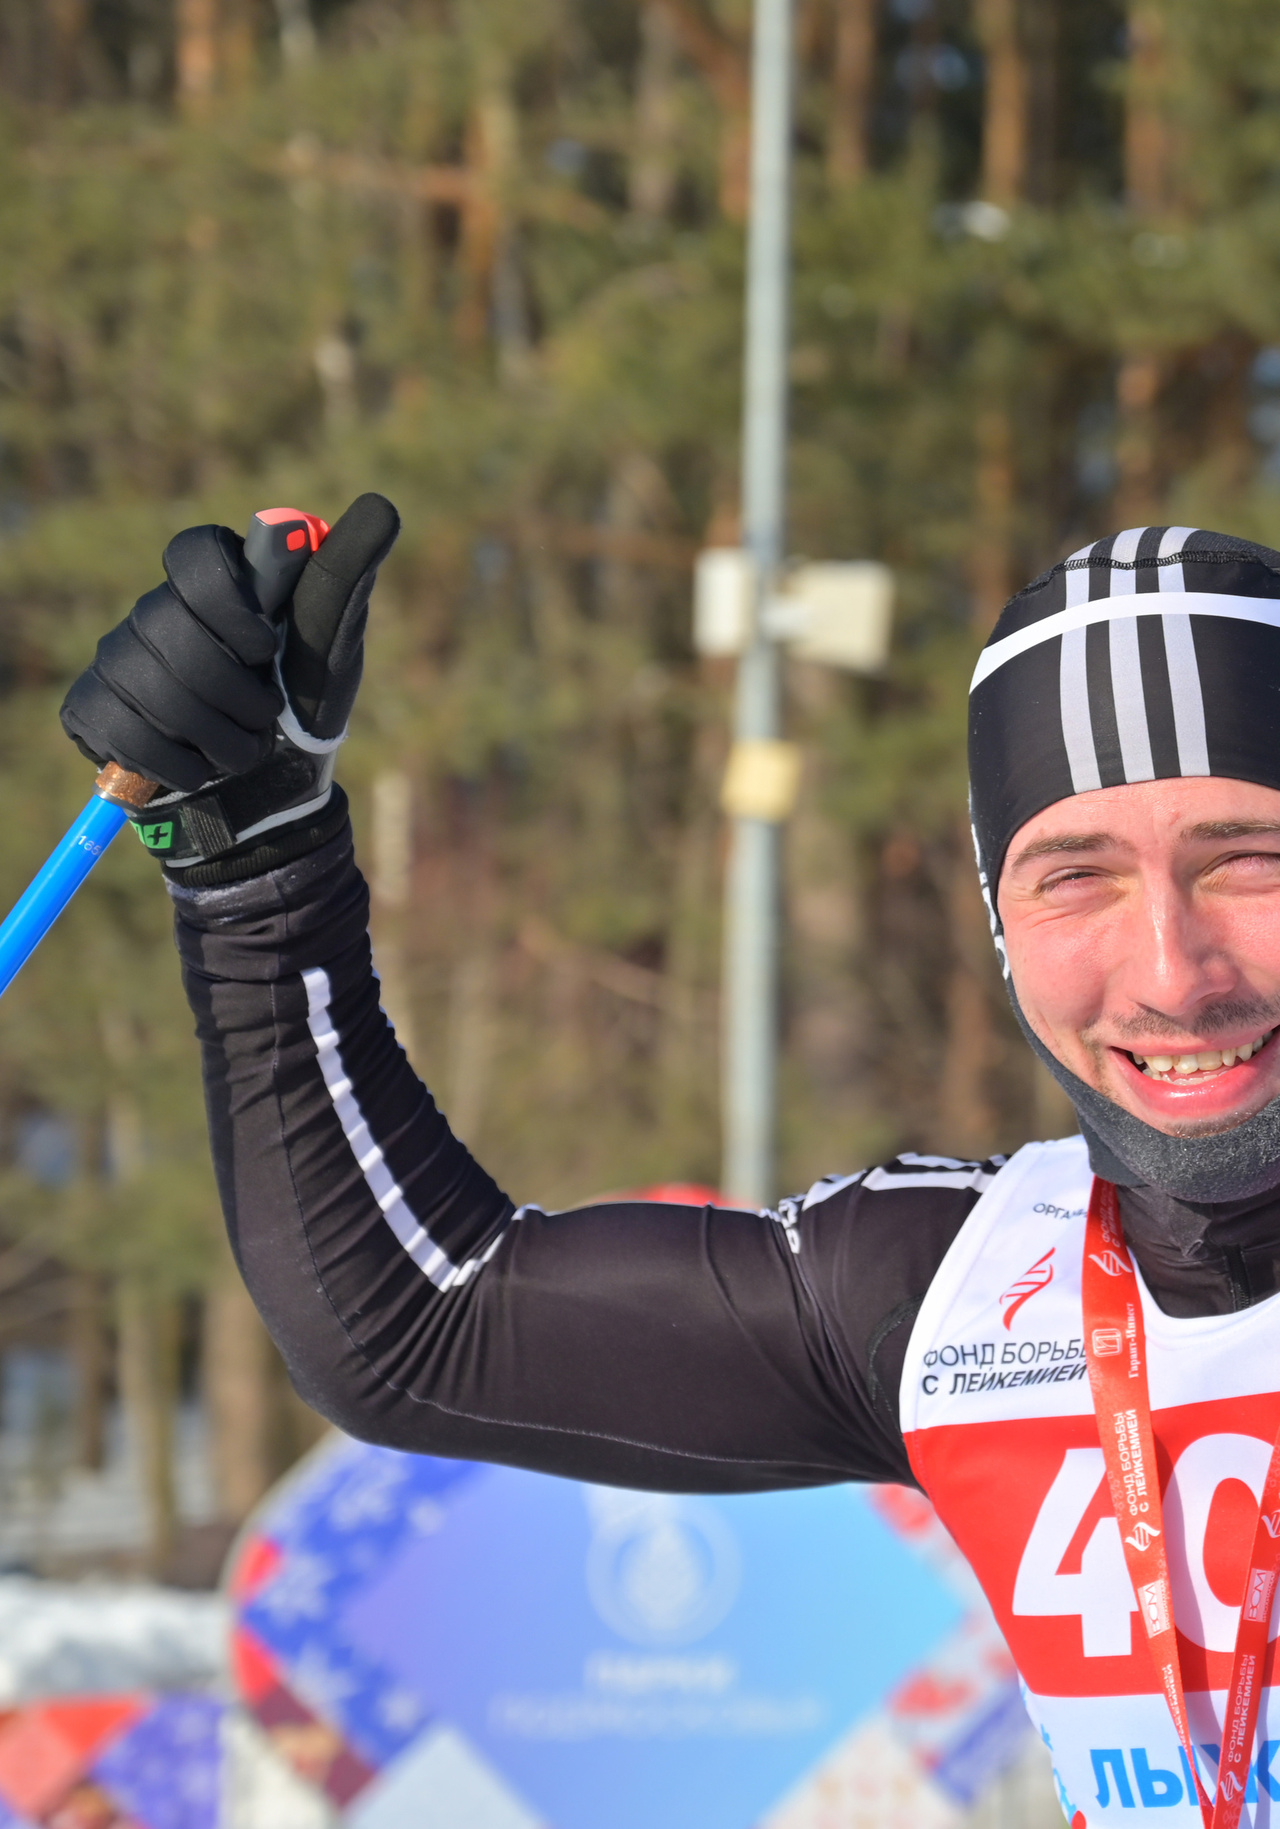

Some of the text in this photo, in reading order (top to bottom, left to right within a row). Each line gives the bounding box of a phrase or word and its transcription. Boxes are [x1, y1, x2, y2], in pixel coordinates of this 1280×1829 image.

[922, 1375, 939, 1395] С
[923, 1343, 996, 1369] ФОНД
[1126, 1302, 1140, 1379] Гарант-Инвест
[1113, 1412, 1138, 1516] ФОНД БОРЬБЫ
[1125, 1409, 1150, 1513] С ЛЕЙКЕМИЕЙ
[1228, 1654, 1248, 1763] ФОНД БОРЬБЫ
[1234, 1655, 1256, 1763] С ЛЕЙКЕМИЕЙ
